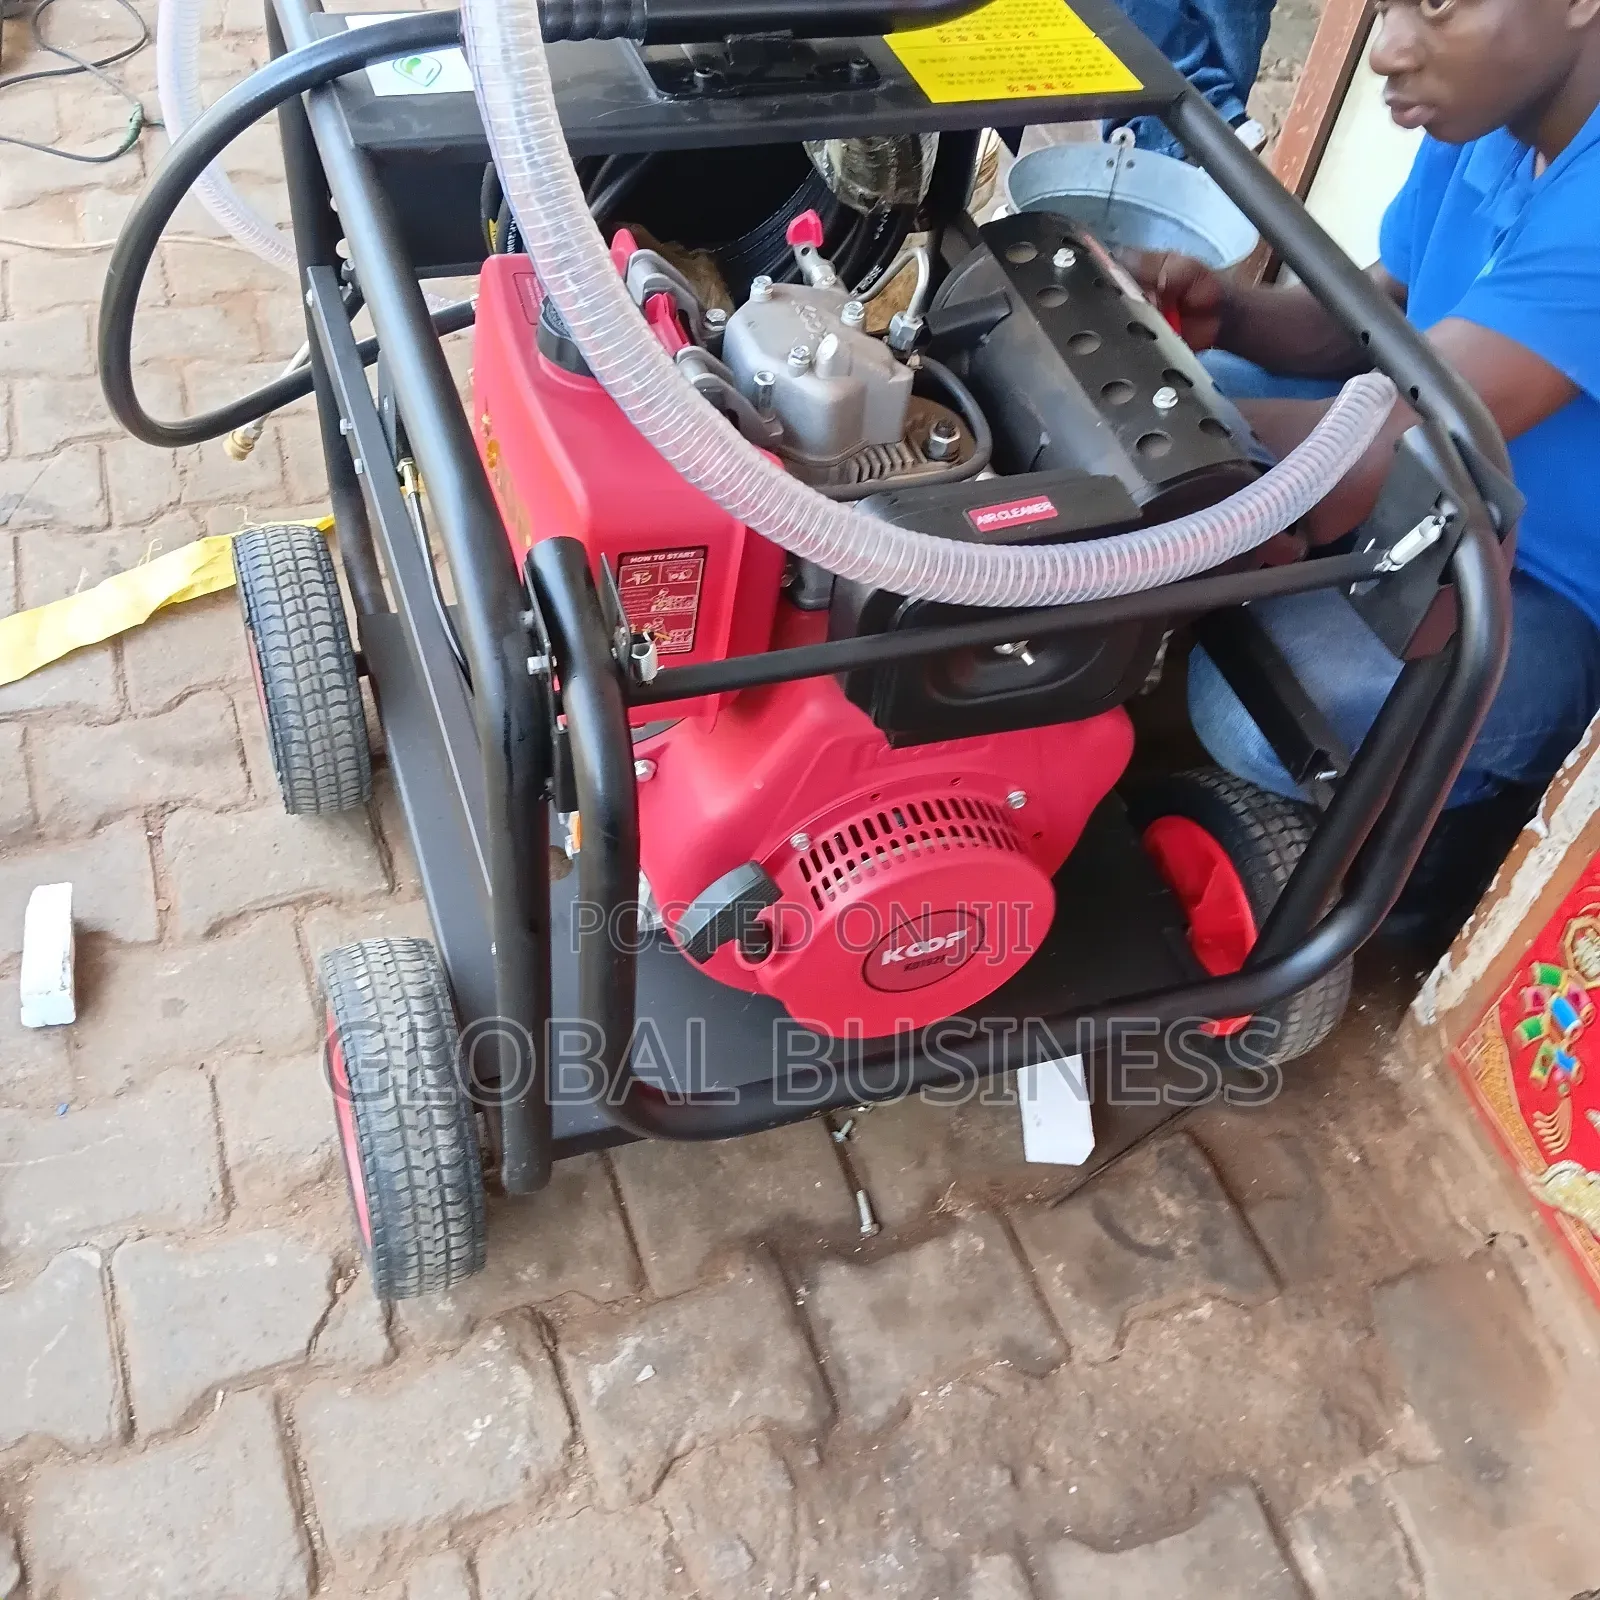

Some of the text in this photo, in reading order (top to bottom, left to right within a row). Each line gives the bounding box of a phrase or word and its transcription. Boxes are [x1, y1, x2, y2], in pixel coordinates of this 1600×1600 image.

[976, 501, 1055, 526] AIR CLEANER
[630, 551, 697, 564] HOW TO START
[881, 928, 969, 966] KOOP
